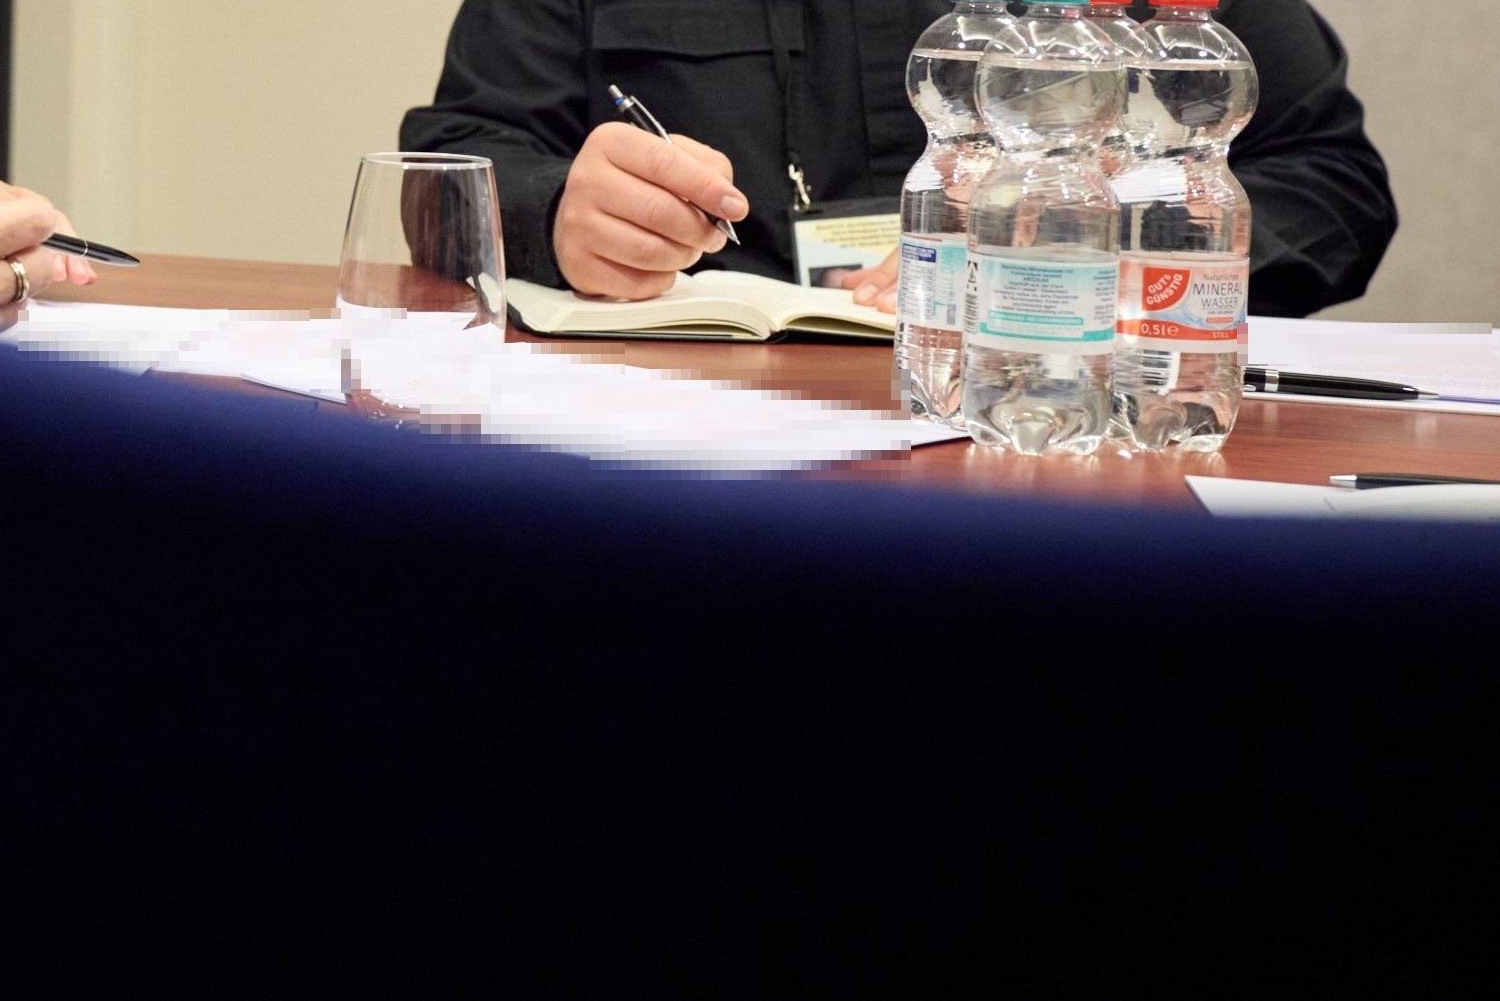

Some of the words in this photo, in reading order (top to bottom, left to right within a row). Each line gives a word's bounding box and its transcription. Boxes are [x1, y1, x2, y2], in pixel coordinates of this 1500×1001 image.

[1146, 273, 1184, 305] GÜNSTIG
[1192, 282, 1243, 296] MINERAL
[1201, 296, 1238, 308] WASSER
